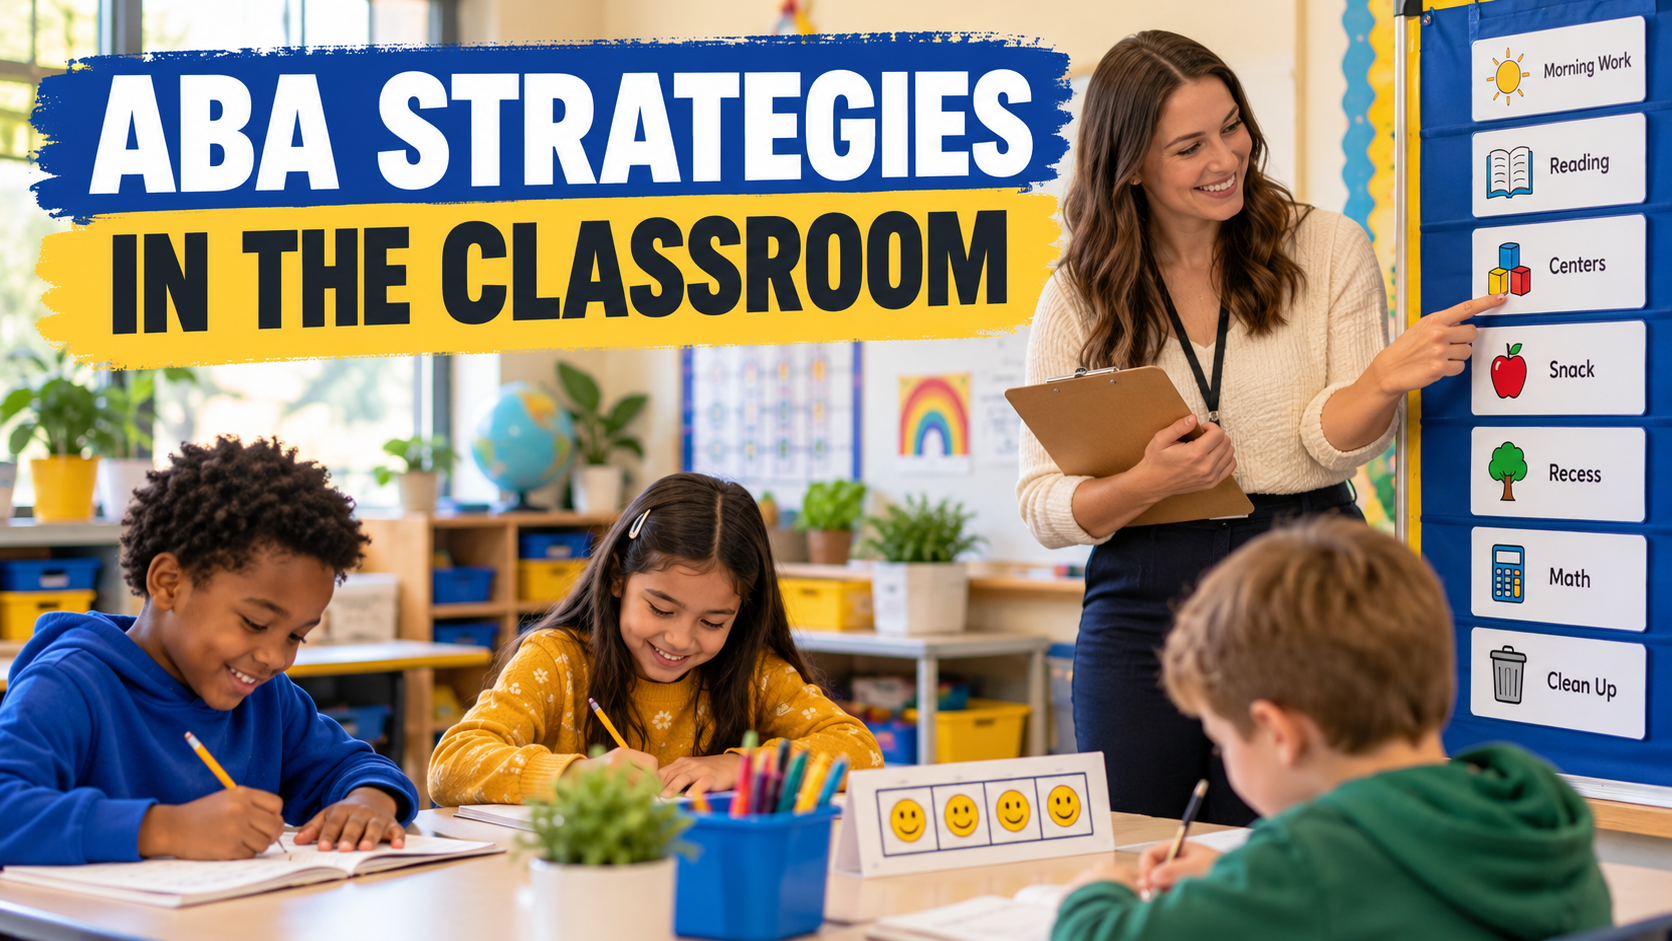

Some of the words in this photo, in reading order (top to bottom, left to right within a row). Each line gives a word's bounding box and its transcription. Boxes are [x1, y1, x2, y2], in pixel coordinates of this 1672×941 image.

[1543, 58, 1595, 79] Morning
[1598, 51, 1632, 72] Work
[1550, 152, 1610, 175] Reading
[1549, 256, 1607, 275] Centers
[1549, 358, 1595, 379] Snack
[1549, 463, 1602, 484] Recess
[1549, 567, 1591, 589] Math
[1547, 670, 1591, 695] Clean
[1595, 676, 1617, 703] Up
